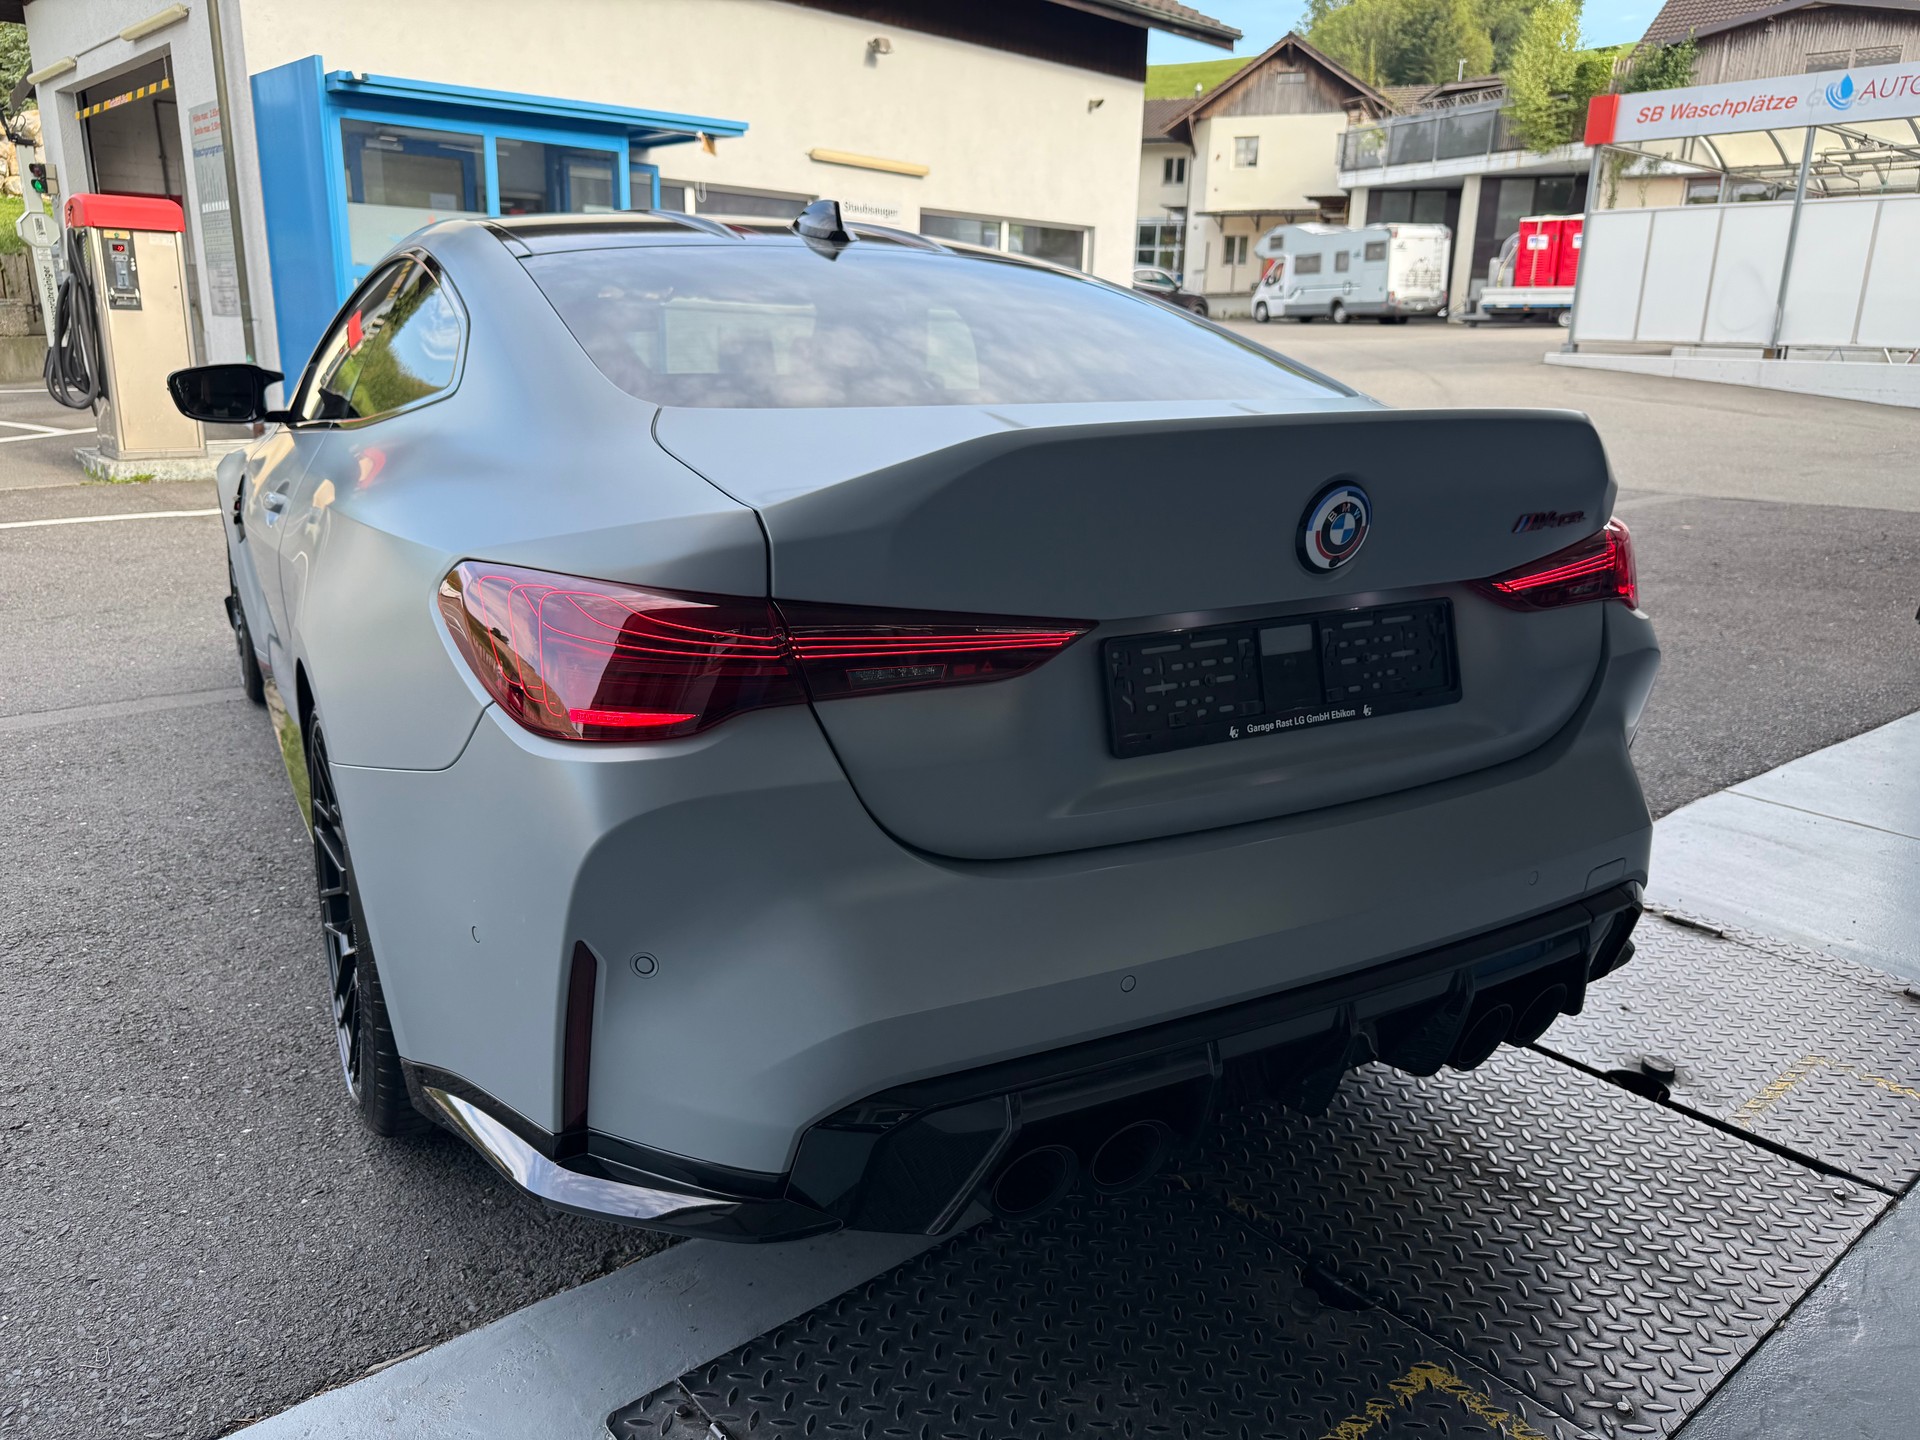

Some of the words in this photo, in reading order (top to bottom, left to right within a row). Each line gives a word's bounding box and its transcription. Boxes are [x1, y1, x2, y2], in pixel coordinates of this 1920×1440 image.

[1636, 105, 1665, 124] SB
[1670, 94, 1798, 120] Waschplätze
[1327, 503, 1361, 522] BMW
[1246, 722, 1275, 734] Garage
[1275, 719, 1293, 729] Rast
[1294, 715, 1305, 725] LG
[1306, 711, 1331, 724] GmbH
[1331, 708, 1356, 720] Ebikon
